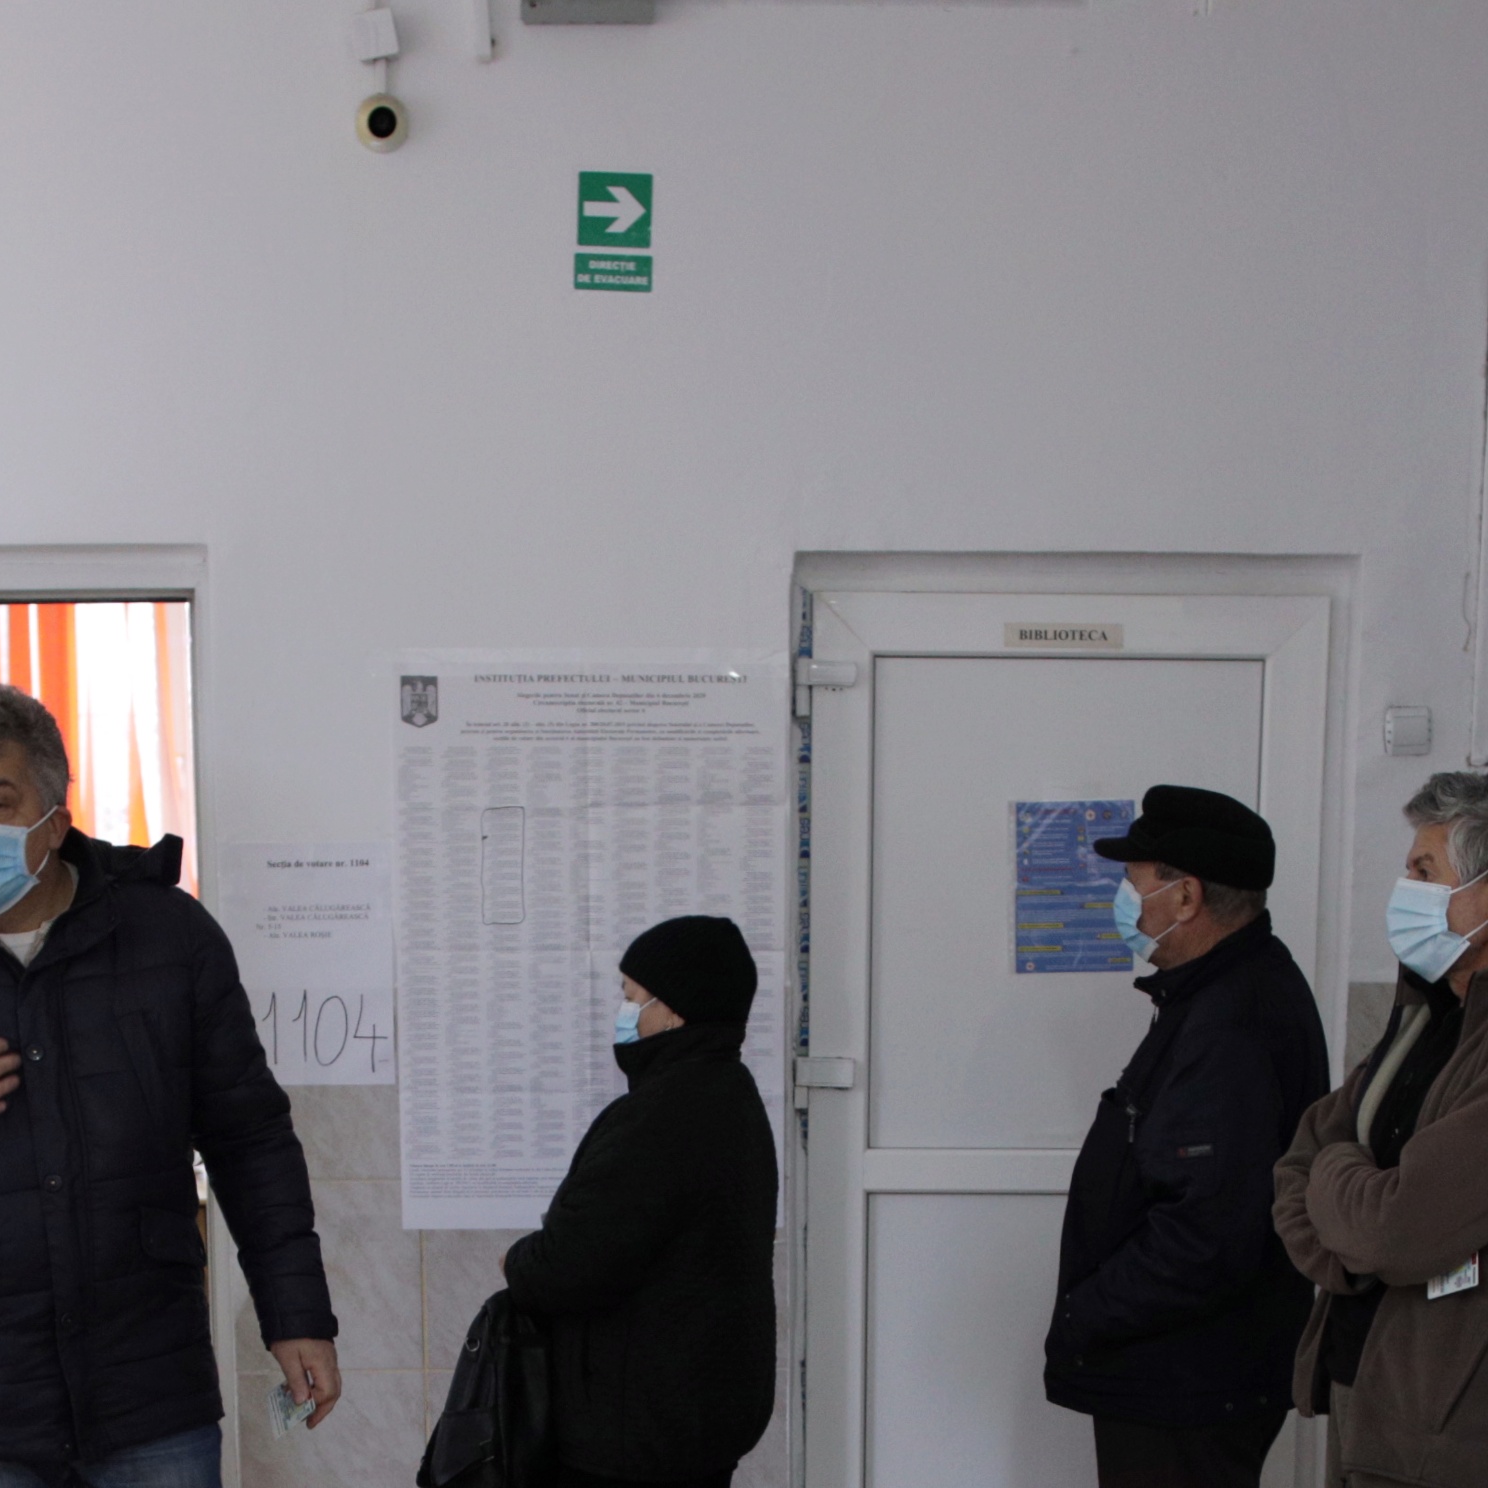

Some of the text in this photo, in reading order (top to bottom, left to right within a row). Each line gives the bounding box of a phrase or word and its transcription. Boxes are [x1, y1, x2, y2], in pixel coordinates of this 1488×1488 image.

[577, 274, 649, 285] DE EVACUARE
[1018, 628, 1109, 642] BIBLIOTECA
[537, 674, 610, 683] PREFECTULUI
[621, 674, 685, 683] MUNICIPIUL
[294, 860, 304, 868] de
[350, 859, 370, 868] 1104
[261, 988, 389, 1074] 1104
